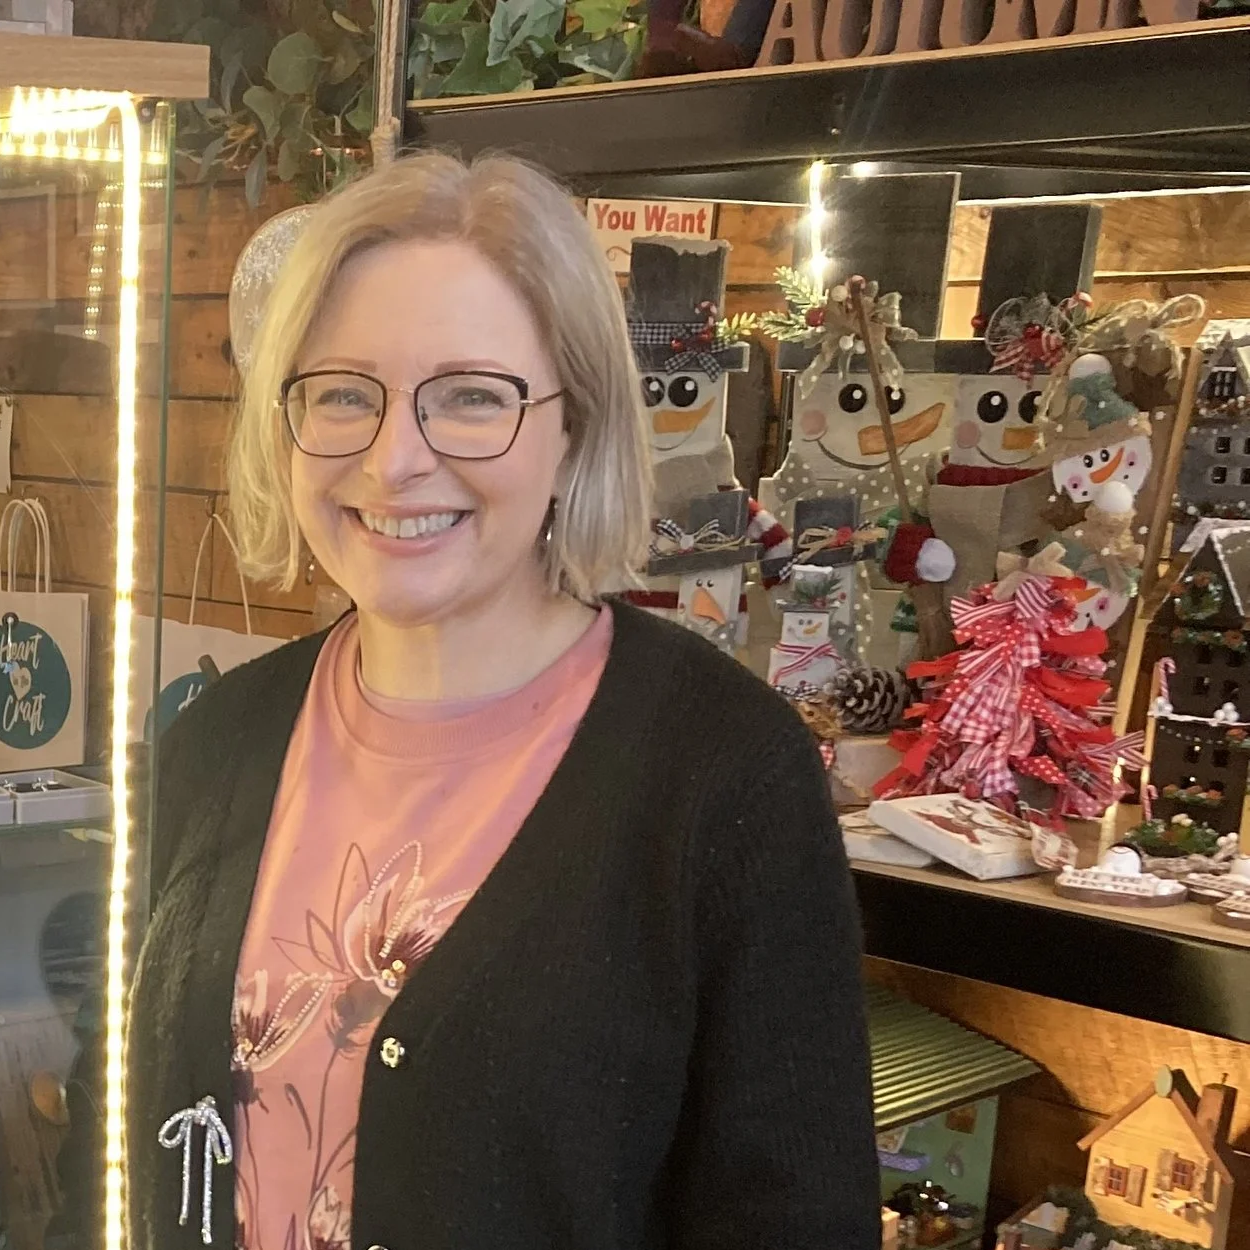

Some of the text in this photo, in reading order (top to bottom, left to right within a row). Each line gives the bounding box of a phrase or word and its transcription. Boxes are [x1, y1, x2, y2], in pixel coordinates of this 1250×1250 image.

[593, 204, 707, 234] You Want
[3, 693, 46, 736] Craft
